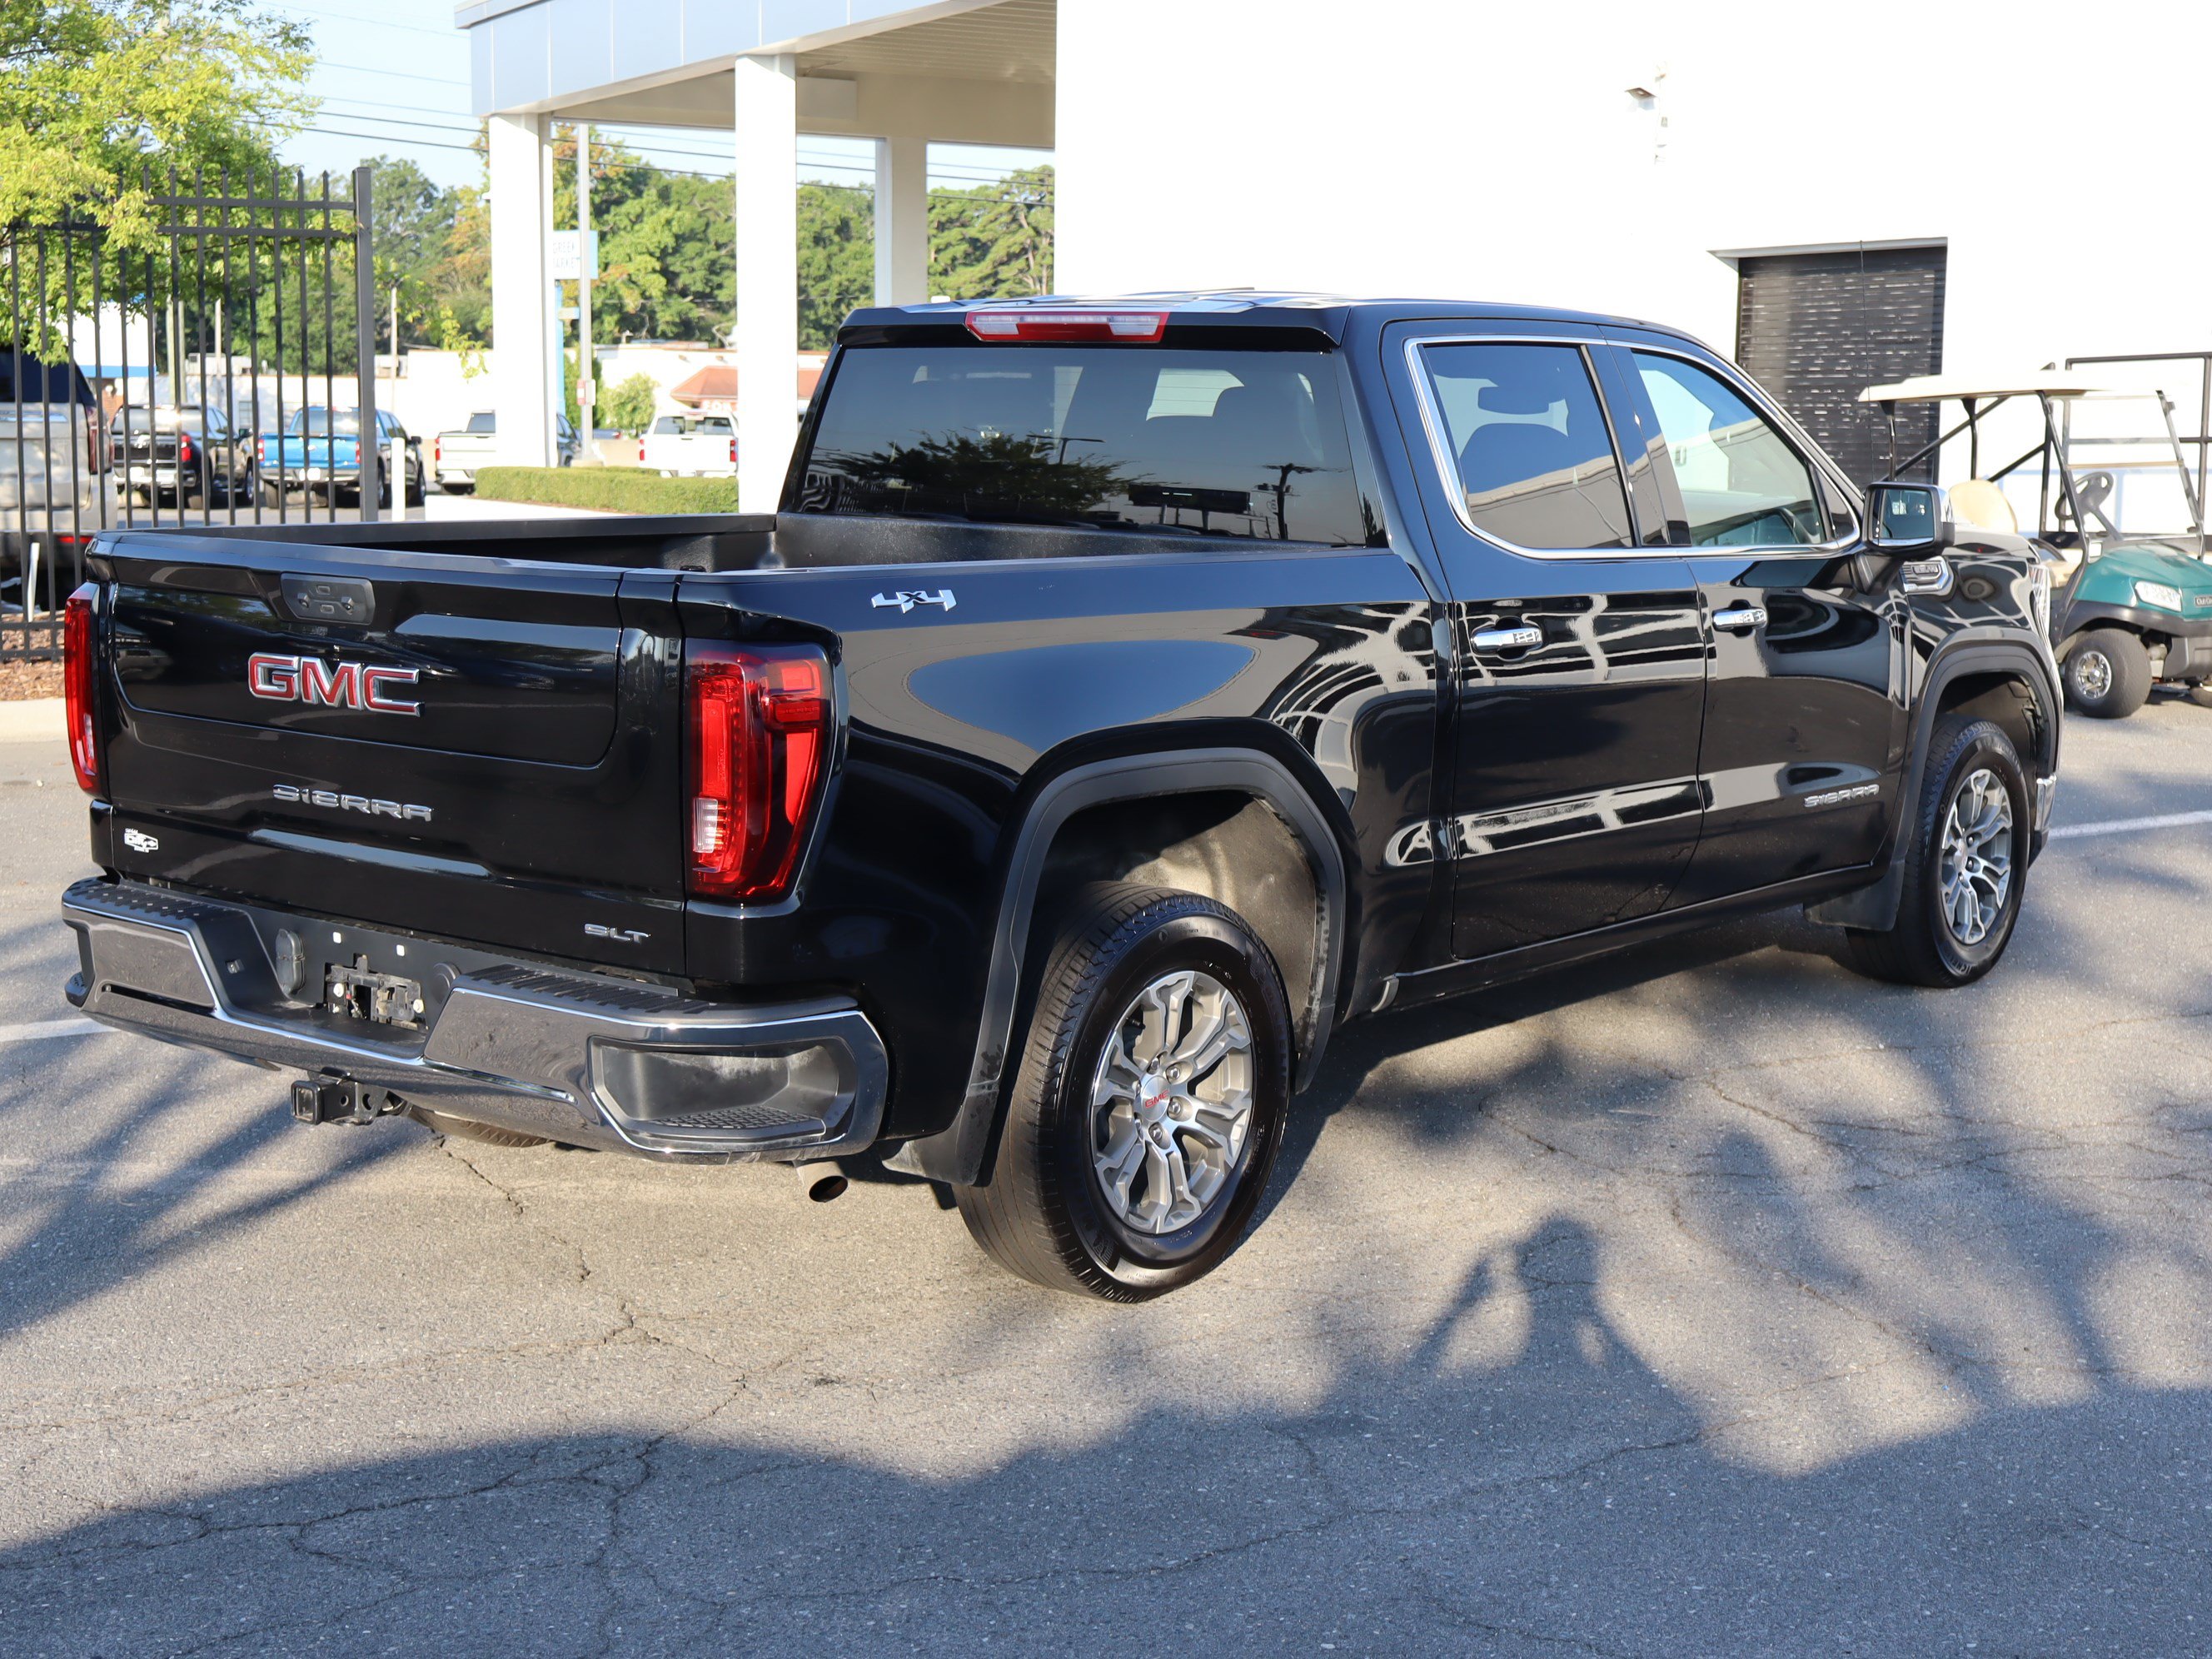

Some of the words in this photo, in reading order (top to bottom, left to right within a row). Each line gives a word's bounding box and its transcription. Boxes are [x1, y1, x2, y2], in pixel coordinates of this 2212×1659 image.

[248, 651, 422, 717] GMC
[272, 784, 433, 822] SIERRA
[1804, 784, 1880, 808] SIERRA
[584, 923, 650, 944] SLT
[1145, 1089, 1169, 1108] GMC
